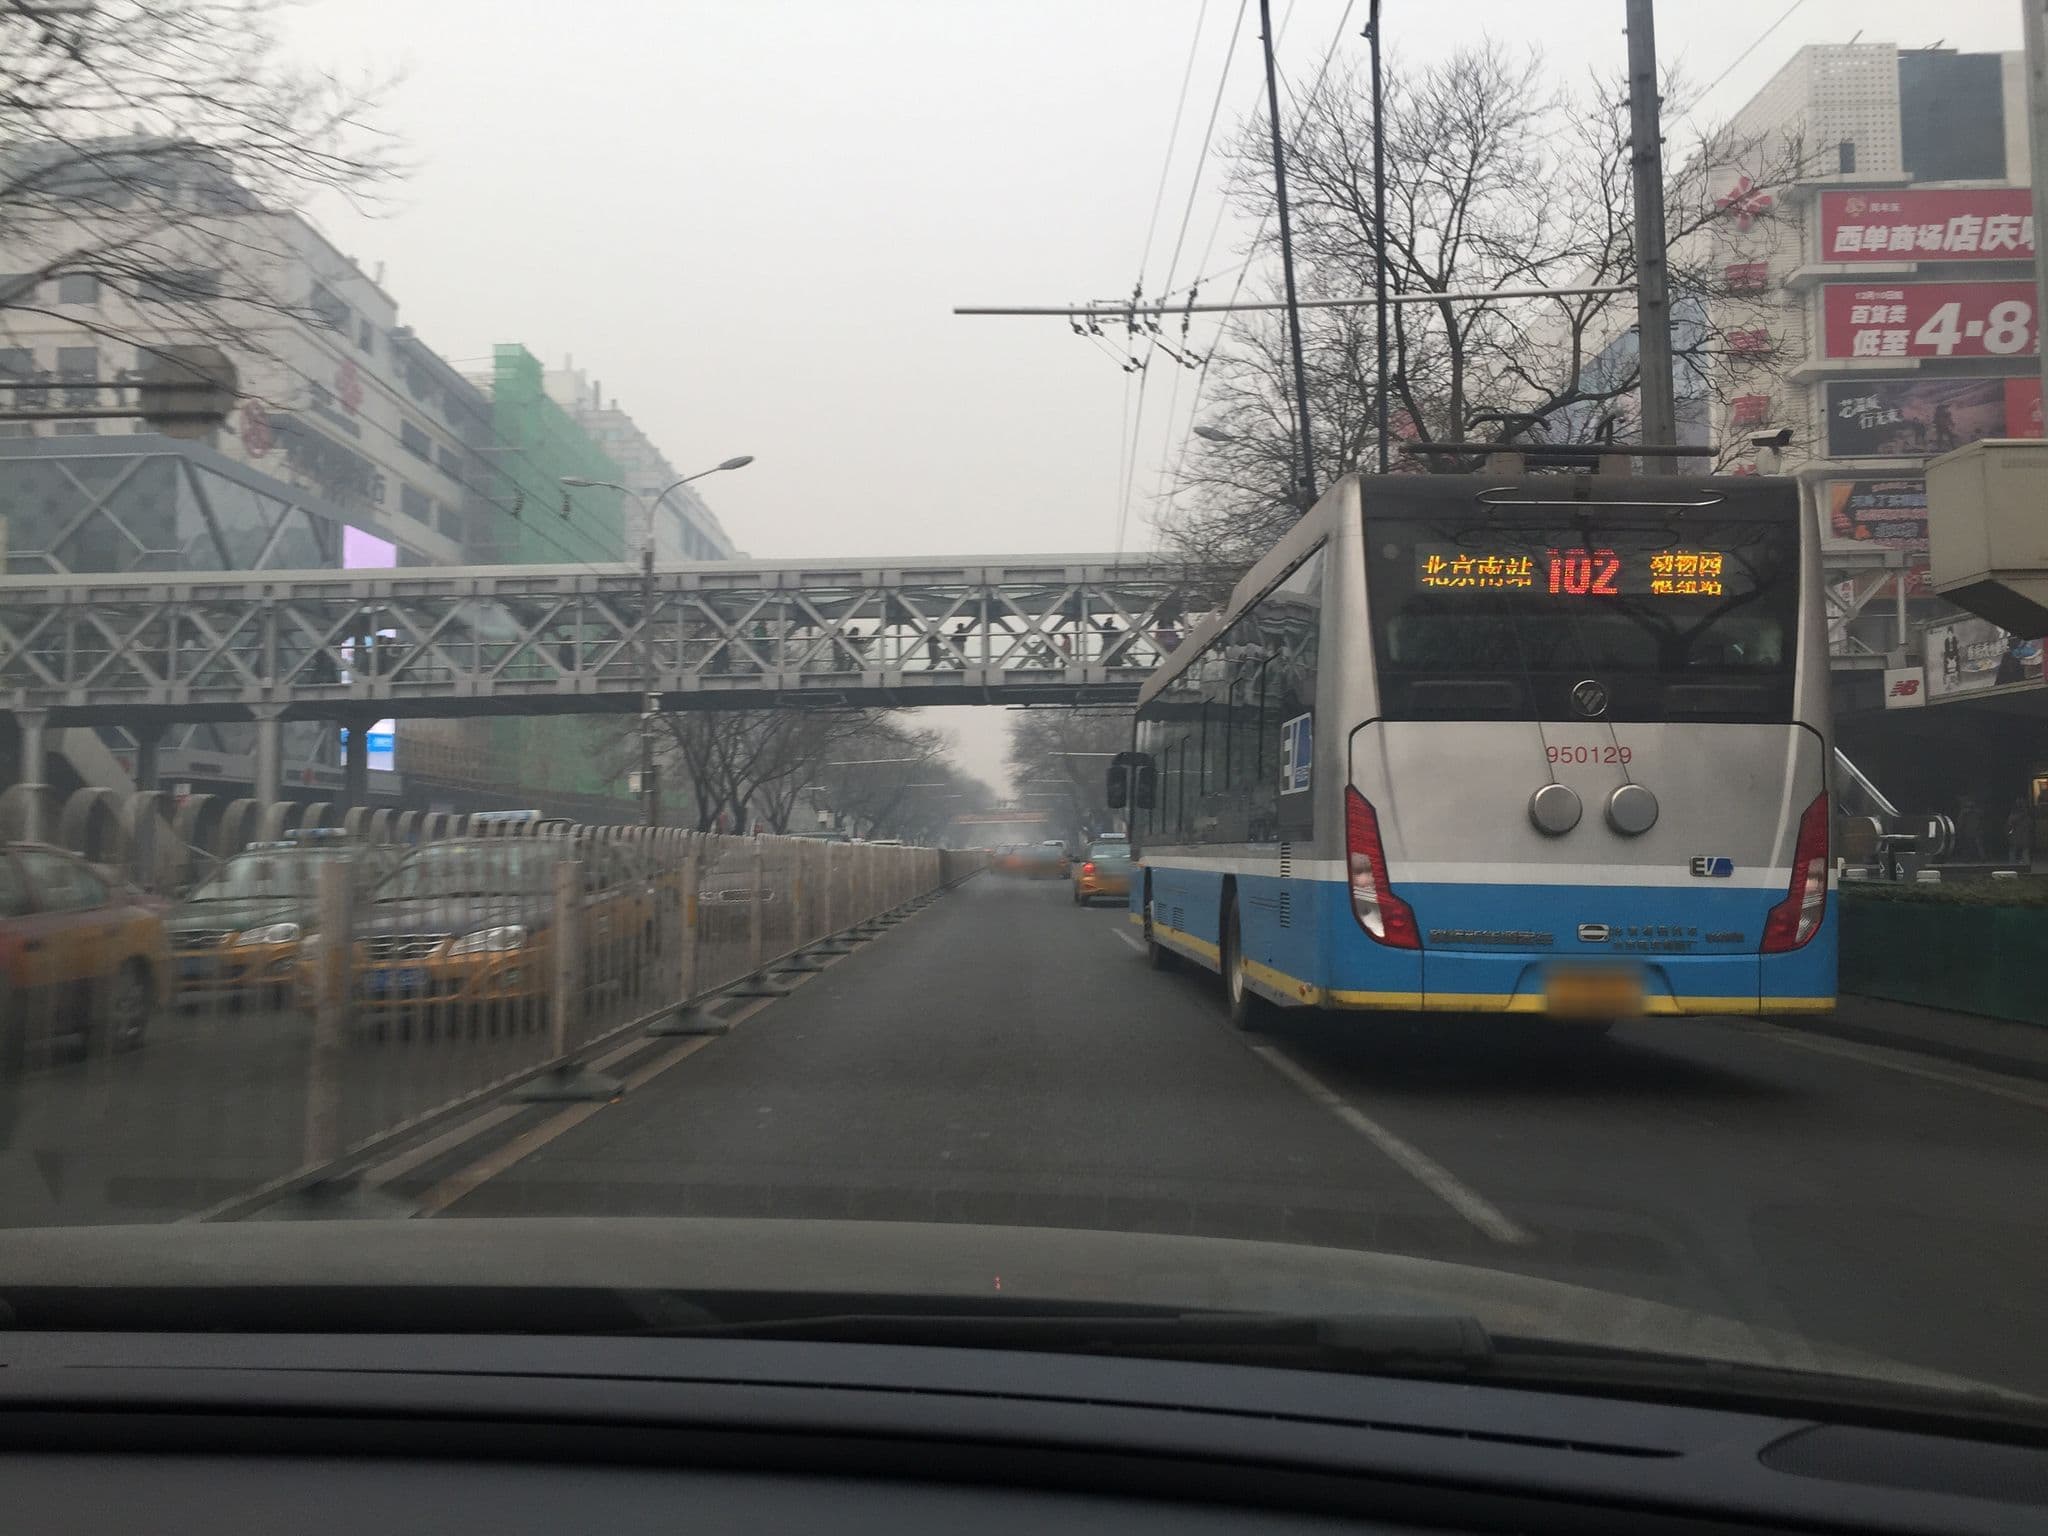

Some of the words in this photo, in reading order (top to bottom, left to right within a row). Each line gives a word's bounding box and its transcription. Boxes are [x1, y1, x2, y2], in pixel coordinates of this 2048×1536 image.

[1852, 329, 1911, 357] 低至
[1421, 554, 1534, 588] 北京南站
[1545, 547, 1621, 595] 102
[1546, 745, 1633, 764] 950129
